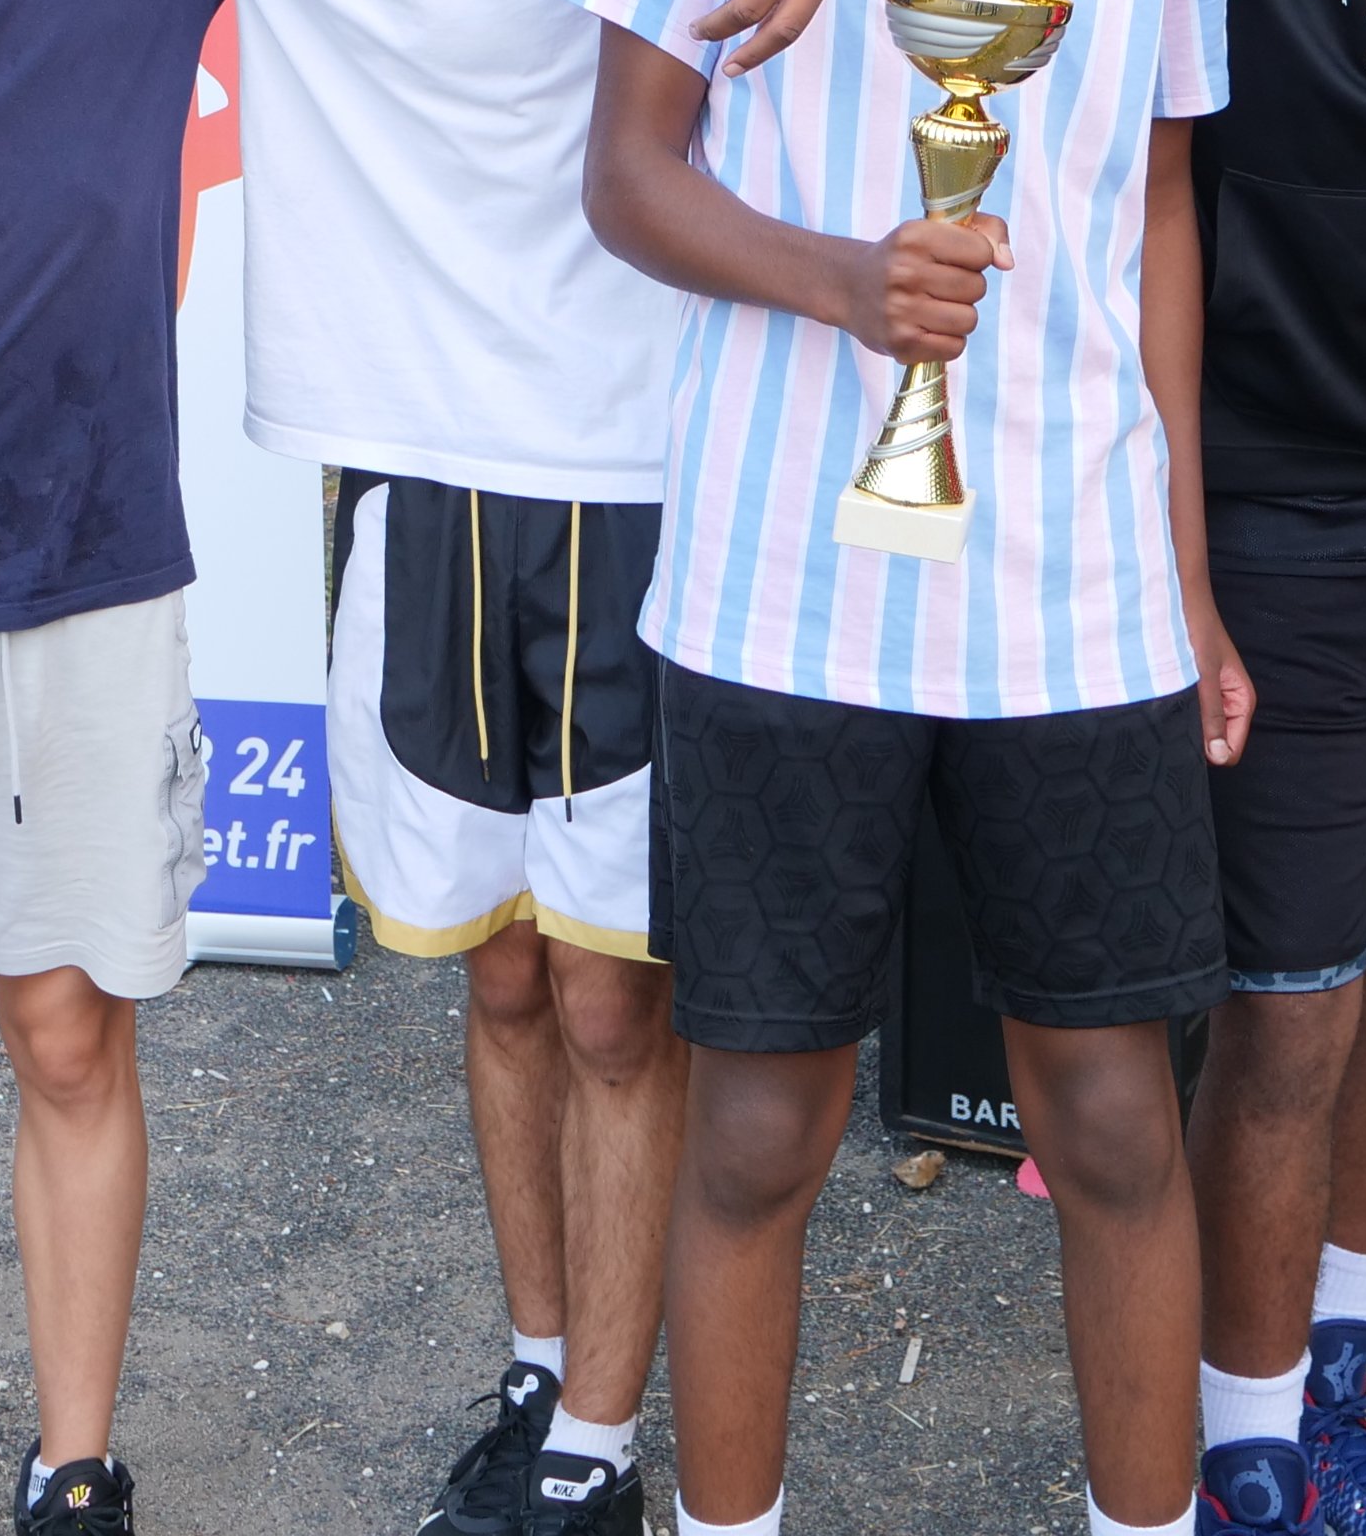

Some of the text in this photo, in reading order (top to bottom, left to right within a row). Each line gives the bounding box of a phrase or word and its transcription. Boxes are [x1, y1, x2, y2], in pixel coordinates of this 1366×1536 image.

[229, 736, 306, 798] 24
[203, 819, 317, 871] et.fr
[950, 1092, 1022, 1131] BAR
[550, 1482, 578, 1498] NIKE
